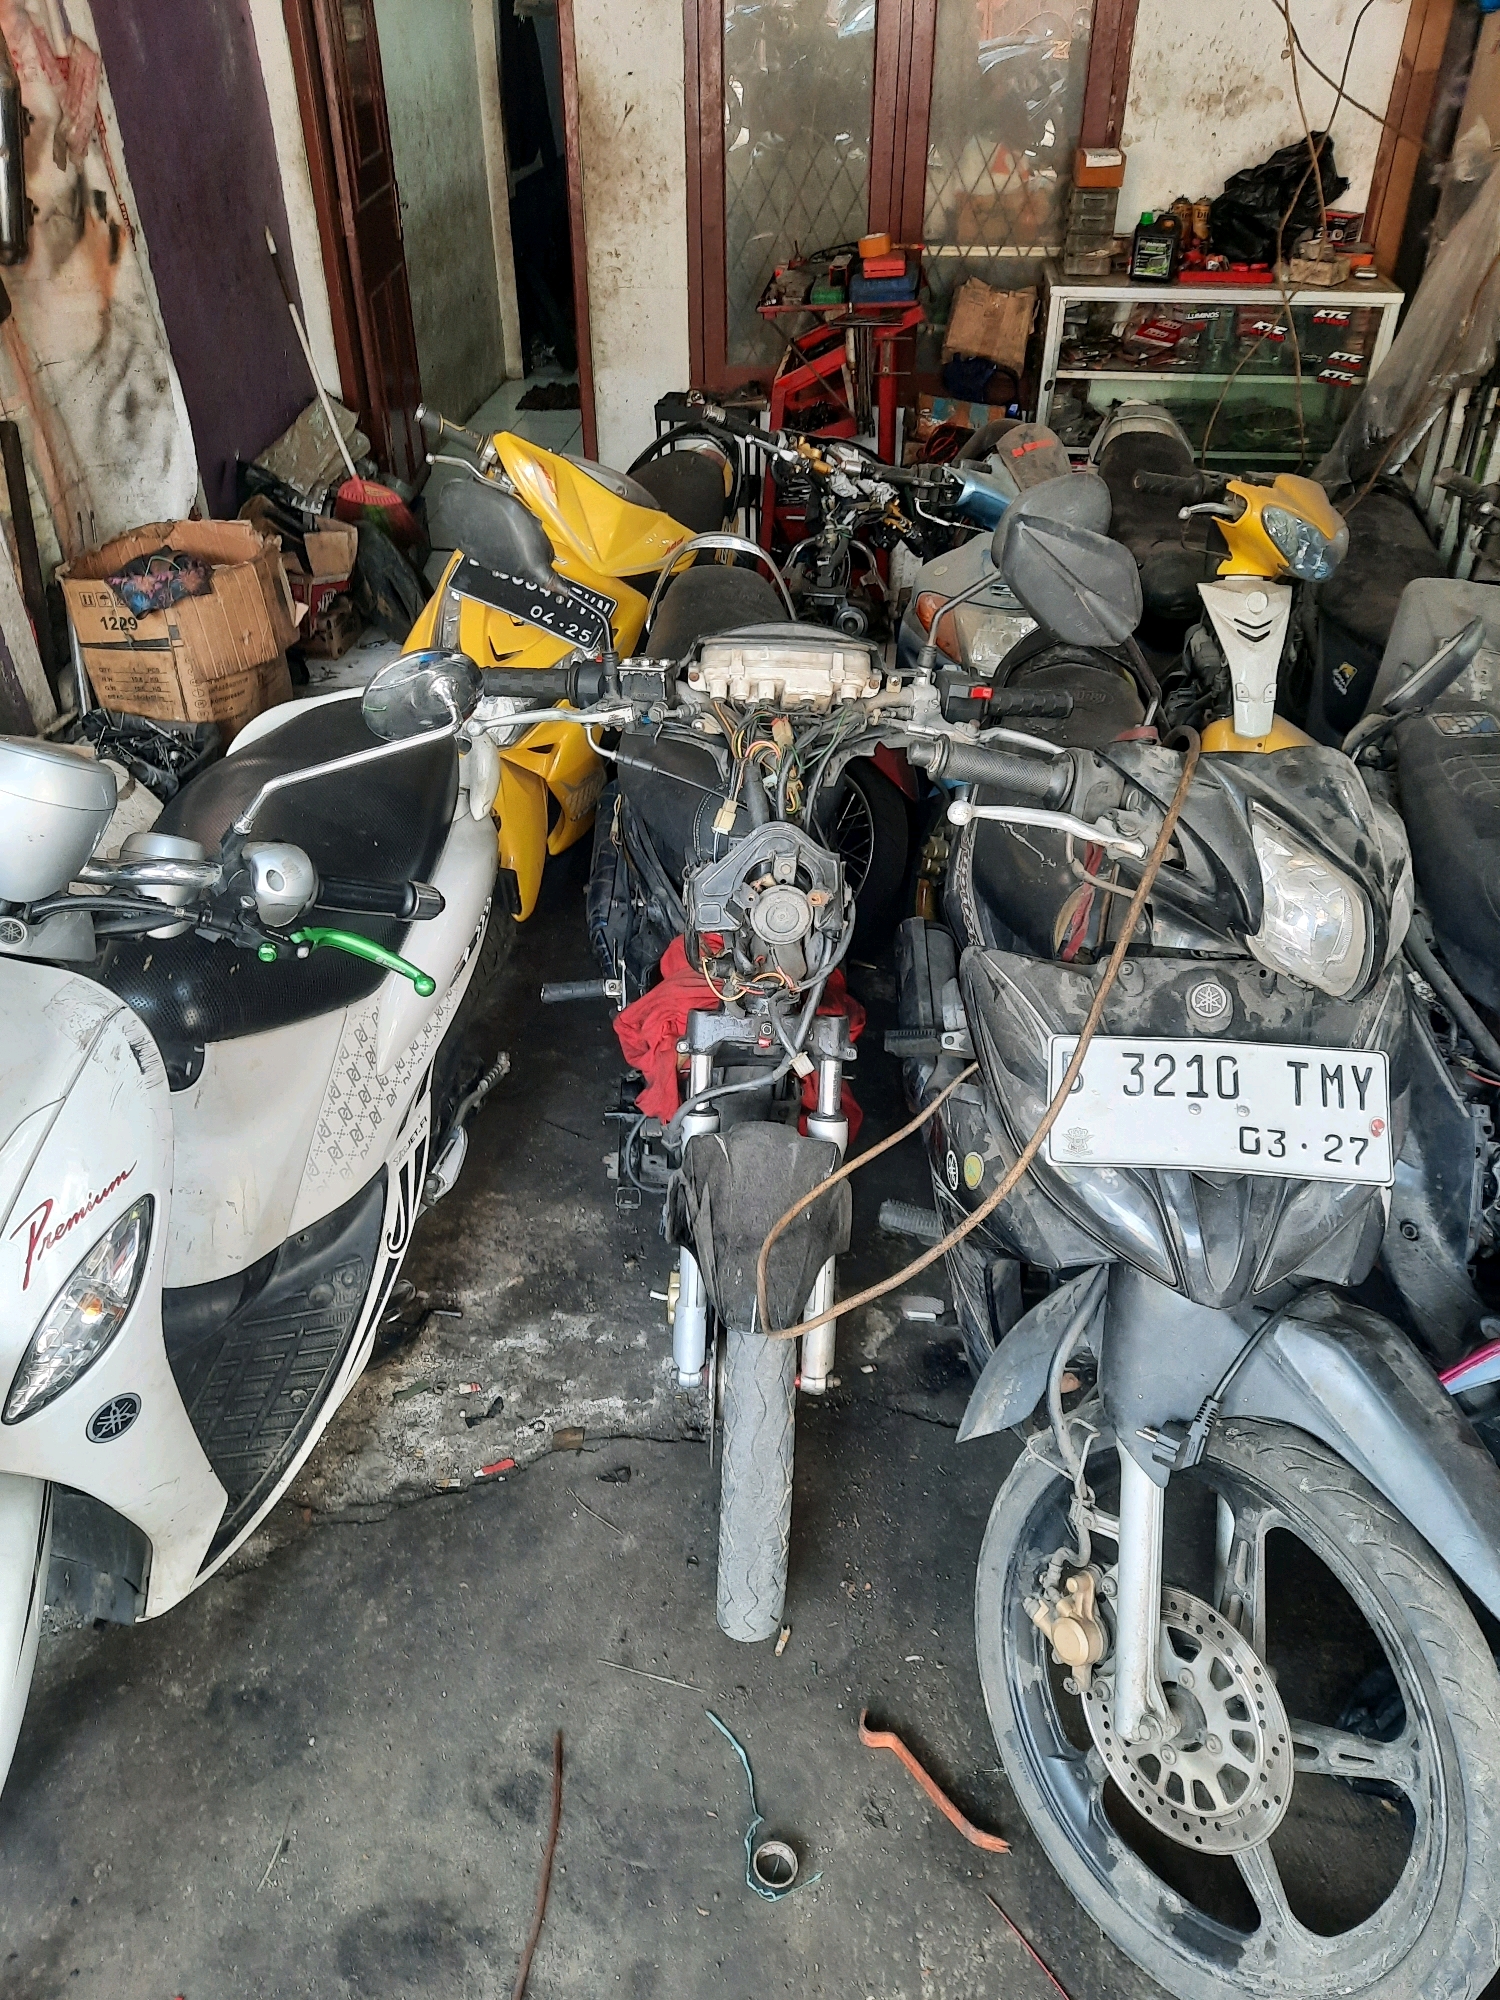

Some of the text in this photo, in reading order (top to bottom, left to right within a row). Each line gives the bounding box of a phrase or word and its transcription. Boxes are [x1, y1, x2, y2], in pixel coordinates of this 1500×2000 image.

[1313, 309, 1352, 320] KTC
[1251, 320, 1289, 335] KTC
[1328, 351, 1365, 363] KTC
[1318, 369, 1356, 381] KTC
[1121, 1052, 1240, 1100] 3210
[1286, 1060, 1374, 1111] TMY
[8, 1159, 138, 1292] Premium
